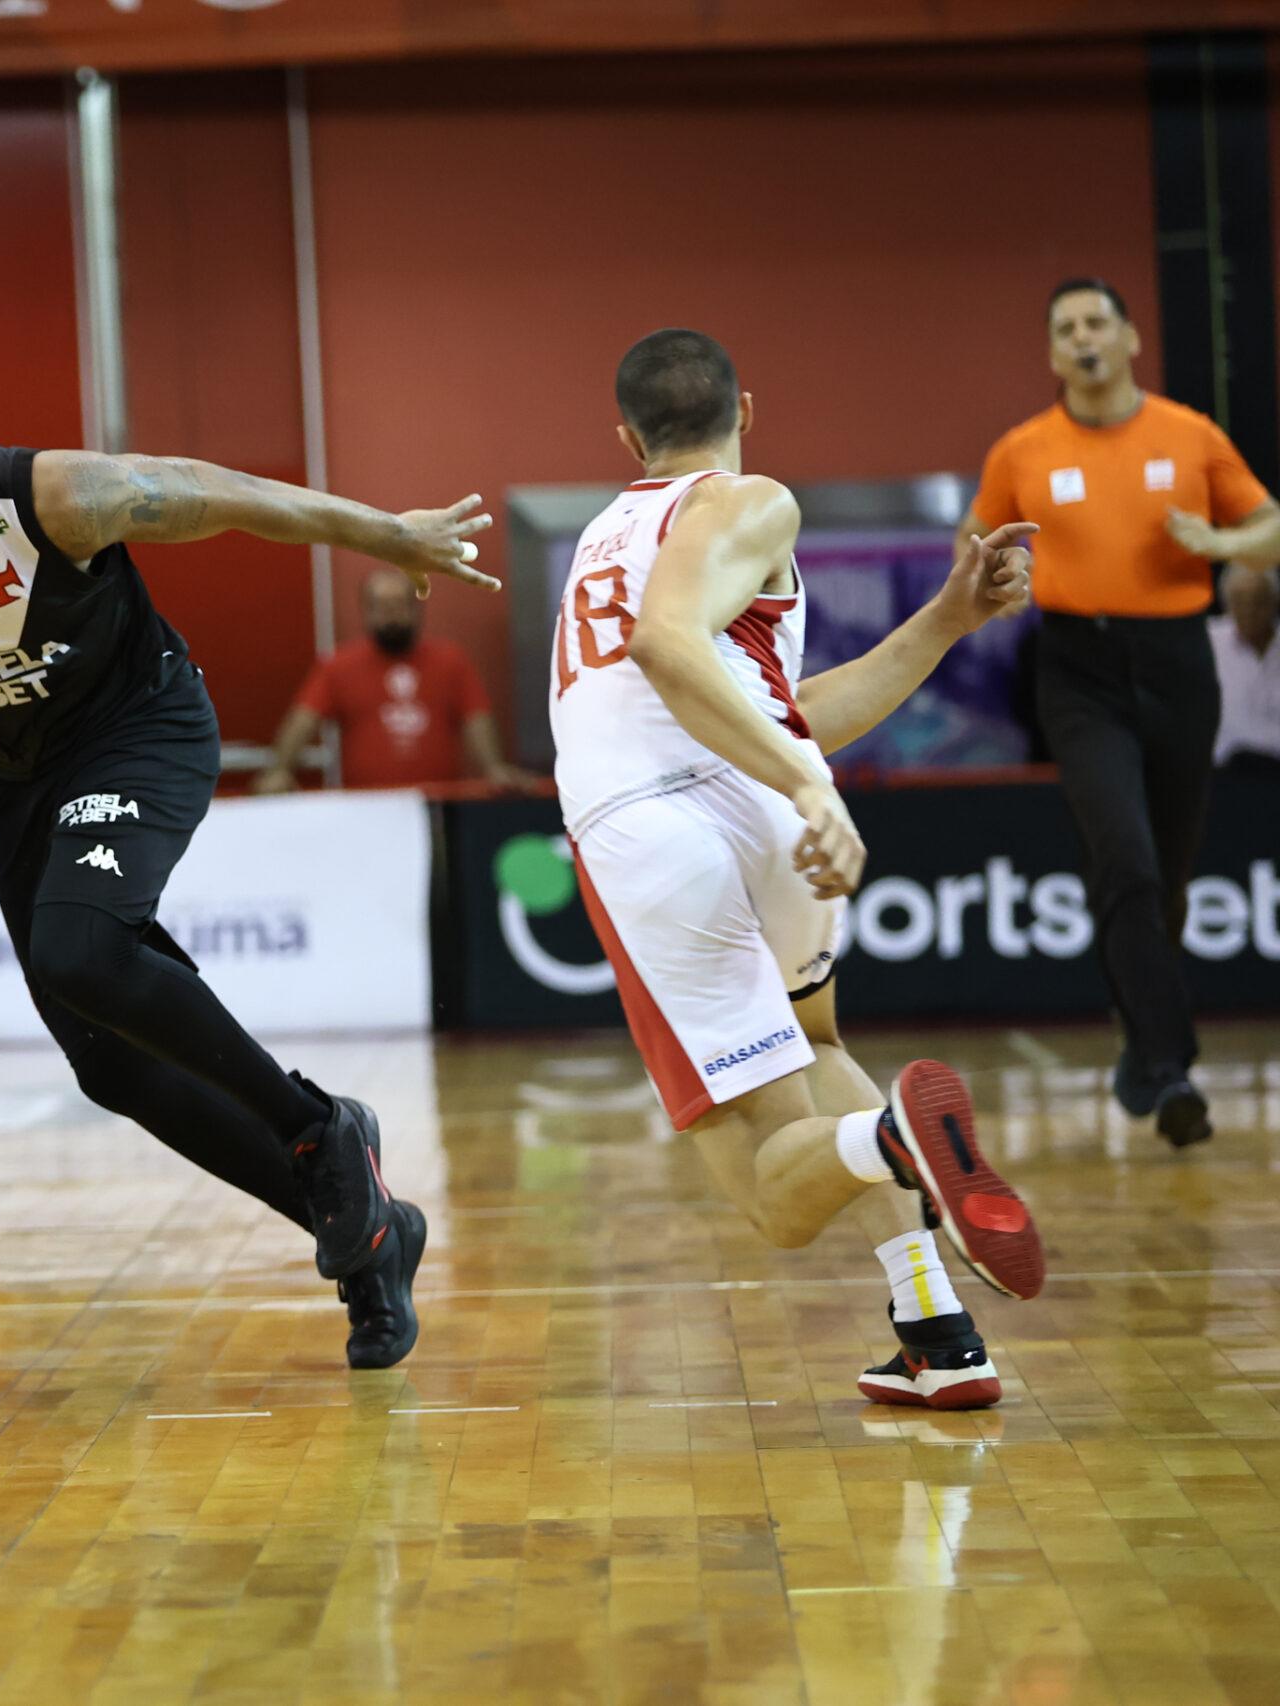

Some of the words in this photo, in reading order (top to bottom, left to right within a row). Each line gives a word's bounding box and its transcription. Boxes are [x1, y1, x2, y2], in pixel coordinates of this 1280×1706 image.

[557, 565, 637, 702] 18
[58, 793, 140, 825] ESTRELA
[80, 808, 123, 824] BET
[838, 856, 1280, 964] ortset
[704, 1025, 797, 1077] BRASANITAS
